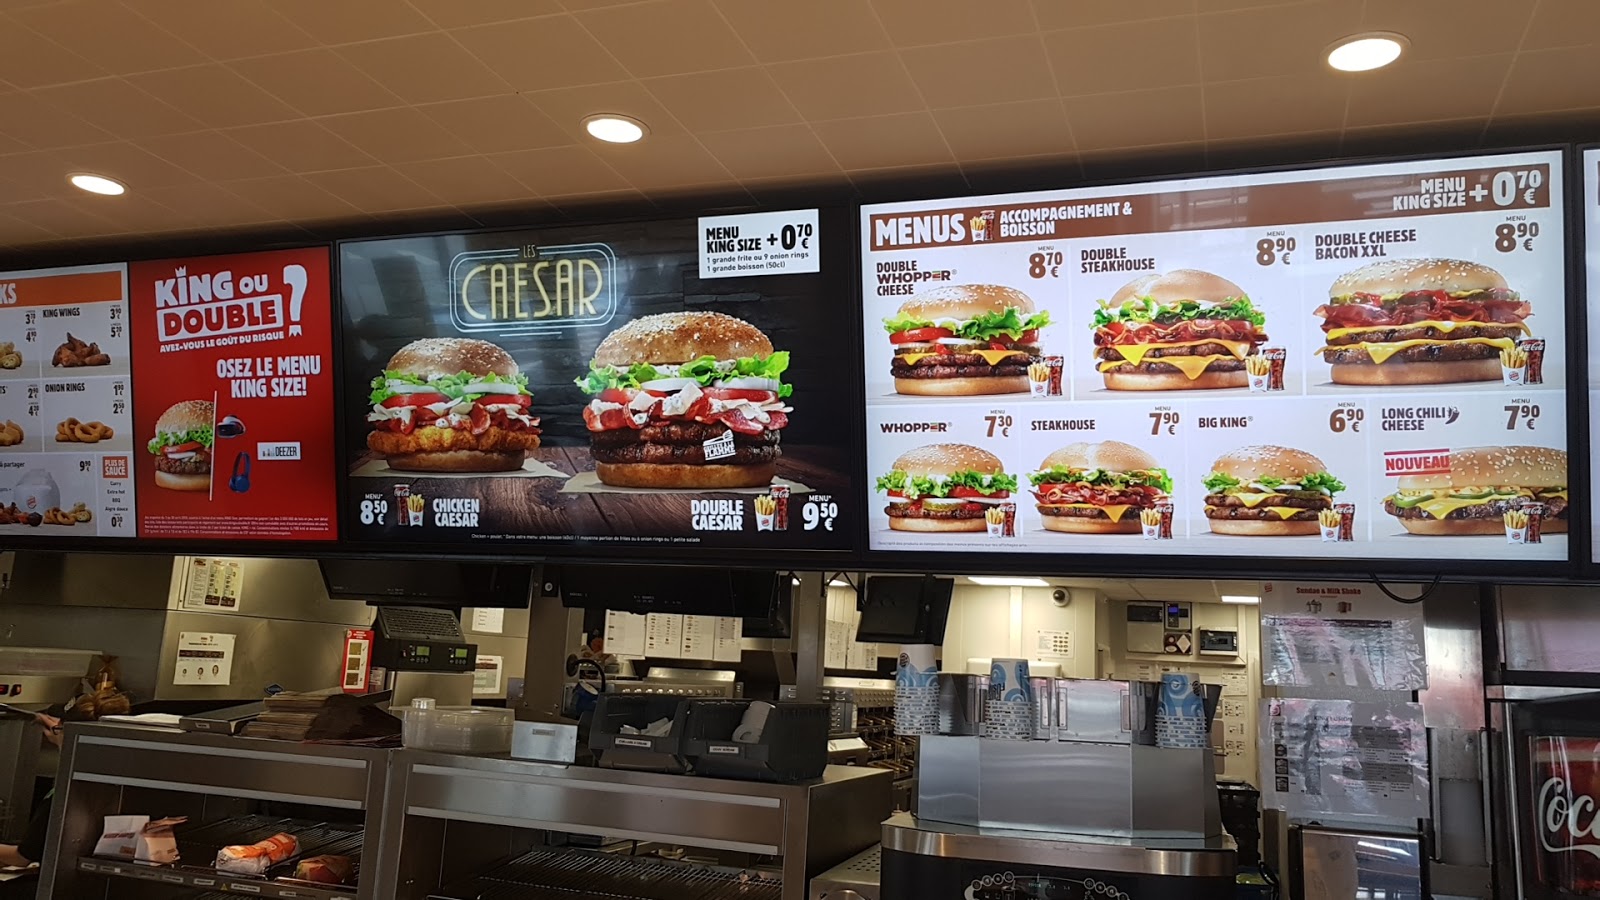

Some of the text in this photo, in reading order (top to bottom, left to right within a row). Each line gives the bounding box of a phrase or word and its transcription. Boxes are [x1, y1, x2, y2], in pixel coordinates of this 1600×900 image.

[1421, 177, 1466, 194] MENU
[1393, 192, 1466, 211] KING SIZE
[875, 201, 1133, 246] MENUS ACCOMPAGNEMENT &
[1000, 222, 1055, 237] BOISSON
[706, 226, 739, 240] MENU
[1315, 229, 1416, 247] DOUBLE CHEESE
[523, 244, 536, 258] LES
[706, 238, 761, 253] KING SIZE
[1315, 245, 1386, 260] BACON XXL
[712, 256, 735, 264] grande
[791, 252, 809, 260] rings
[1081, 247, 1127, 261] DOUBLE
[712, 264, 736, 273] grande
[766, 261, 785, 269] (50cl)
[877, 260, 917, 273] DOUBLE
[1081, 258, 1155, 274] STEAKHOUSE
[154, 270, 234, 308] KING
[462, 258, 602, 320] CAESAR
[877, 284, 914, 296] CHEESE
[42, 307, 80, 318] KING WINGS
[163, 300, 277, 337] DOUBLE
[160, 331, 284, 353] AVEZ-VOUS LE GOÛT DU RISQUE
[216, 355, 321, 378] OSEZ LE MENU
[45, 382, 85, 392] ONION RINGS
[230, 377, 307, 398] KING SIZE!
[1382, 407, 1446, 419] LONG CHILI
[1031, 420, 1096, 431] STEAKHOUSE
[1198, 417, 1217, 428] BIG
[1382, 420, 1424, 431] CHEESE
[275, 446, 297, 456] DEEZER
[1385, 456, 1450, 470] NOUVEAU
[105, 466, 126, 476] SAUCE
[433, 498, 480, 513] CHICKEN
[691, 500, 744, 515] DOUBLE
[435, 513, 478, 527] CAESAR
[692, 515, 743, 531] CAESAR
